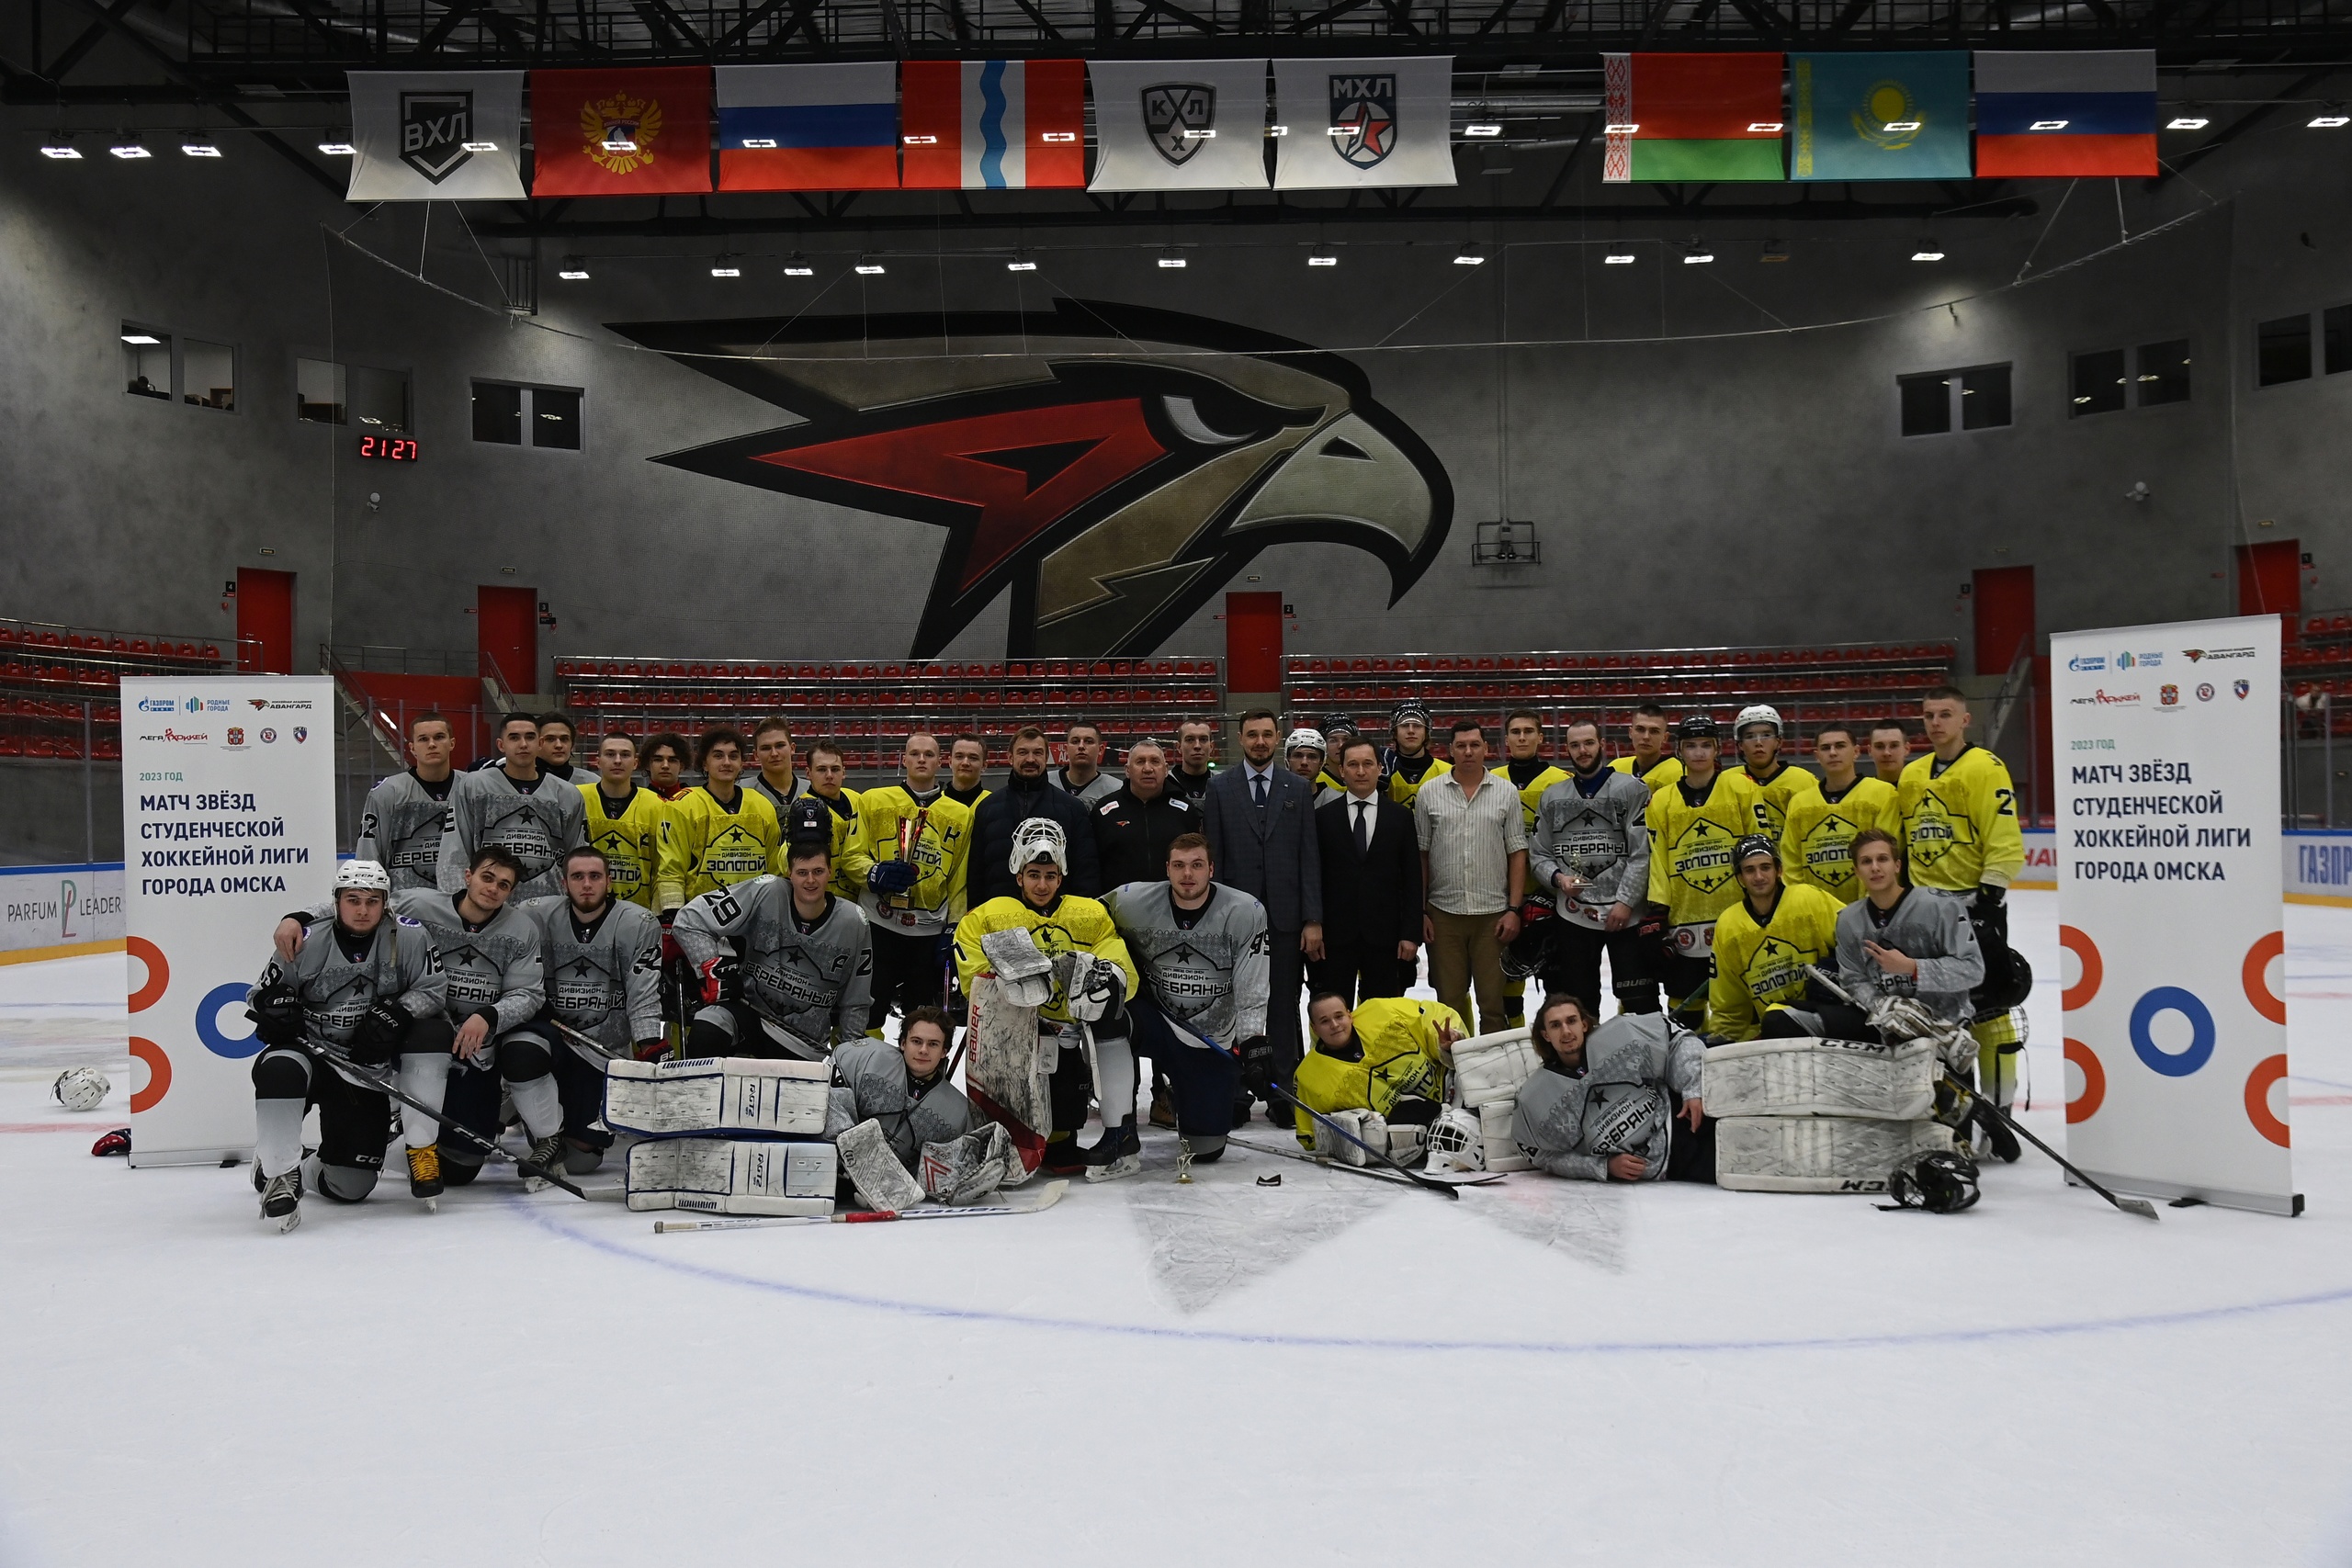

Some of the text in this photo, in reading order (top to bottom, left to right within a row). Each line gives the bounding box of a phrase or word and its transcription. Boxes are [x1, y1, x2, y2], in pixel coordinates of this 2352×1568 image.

[1332, 77, 1393, 99] МХЛ
[404, 111, 467, 152] ВХЛ
[2071, 739, 2116, 750] 2023 ГОД
[139, 772, 183, 782] 2023 ГОД
[2072, 759, 2192, 784] МАТЧ ЗВЁЗД
[141, 790, 256, 812] МАТЧ ЗВЁЗД
[2073, 790, 2223, 818] СТУДЕНЧЕСКОЙ
[141, 817, 284, 841] СТУДЕНЧЕСКОЙ
[506, 833, 546, 842] ДИВИЗИОН
[2074, 824, 2251, 848] ХОККЕЙНОЙ ЛИГИ
[141, 845, 309, 867] ХОККЕЙНОЙ ЛИГИ
[1554, 842, 1625, 856] ЕРЕБРЯНЫ
[707, 856, 766, 872] ЗОЛОТОЙ
[1675, 852, 1730, 873] ЗОЛОТО
[2075, 861, 2226, 883] ГОРОДА ОМСКА
[142, 875, 287, 897] ГОРОДА ОМСКА
[7, 901, 57, 922] PARFUM
[80, 896, 122, 916] LEADER
[702, 886, 742, 927] 29
[447, 974, 486, 986] ИВИЗИОН
[1162, 972, 1204, 981] ДИВИЗИОН
[968, 1003, 980, 1064] BAUER
[1819, 1039, 1886, 1054] CCM
[662, 1057, 715, 1069] WARRIOR
